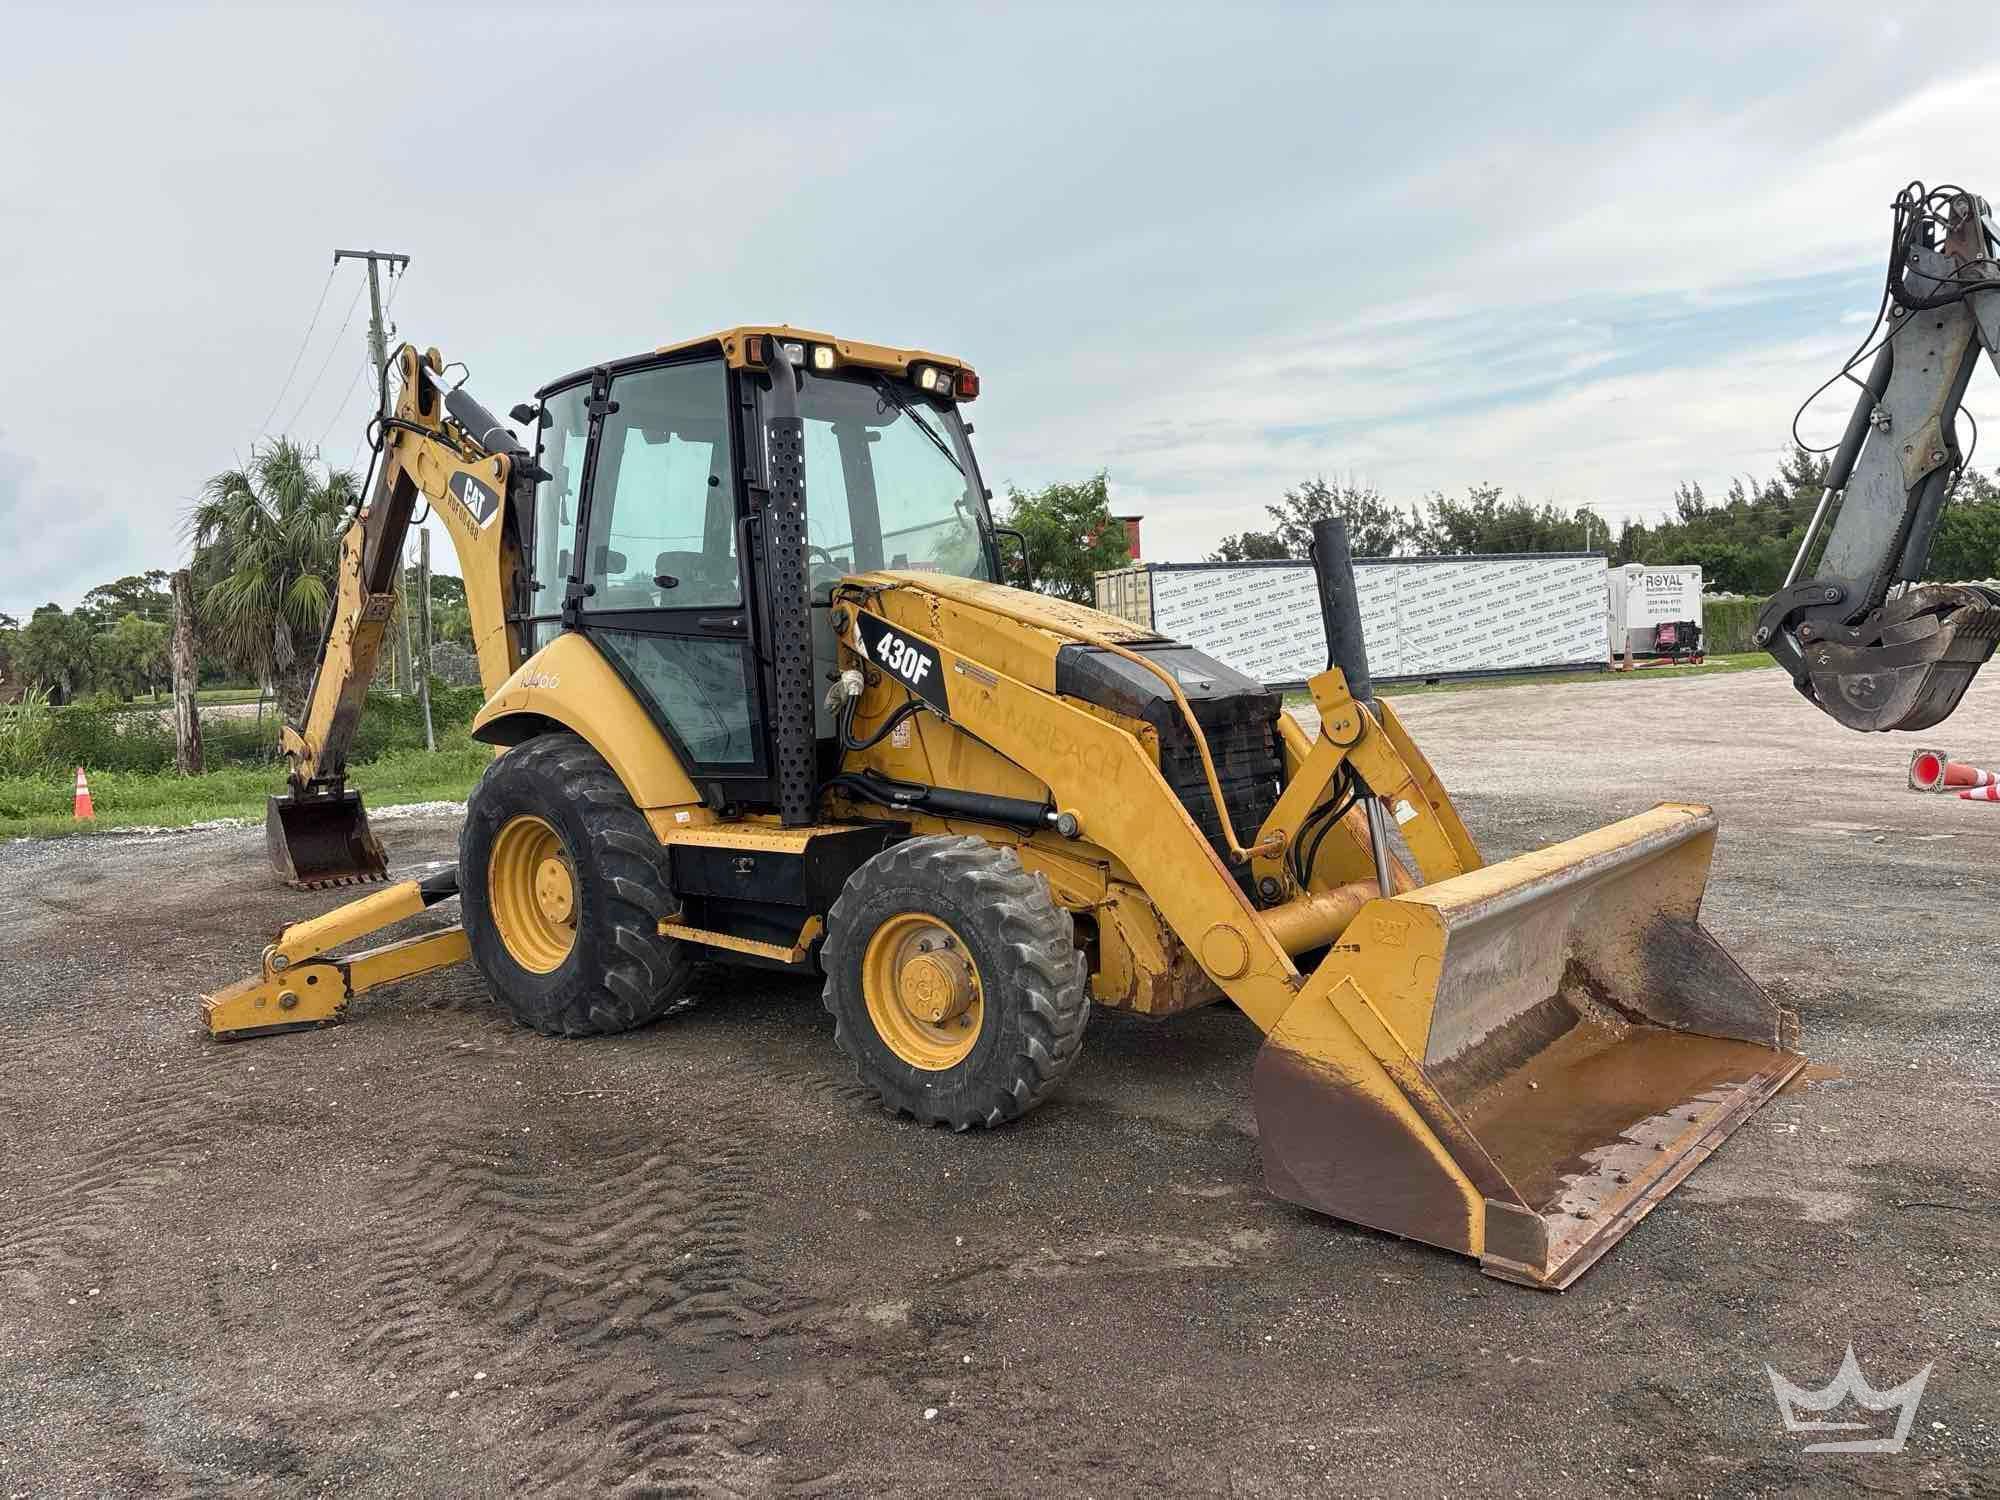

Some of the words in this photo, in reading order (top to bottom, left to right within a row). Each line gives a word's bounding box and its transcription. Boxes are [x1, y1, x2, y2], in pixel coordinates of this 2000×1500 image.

[464, 478, 485, 520] CAT
[1646, 574, 1683, 587] ROYAL
[877, 632, 931, 684] 430F
